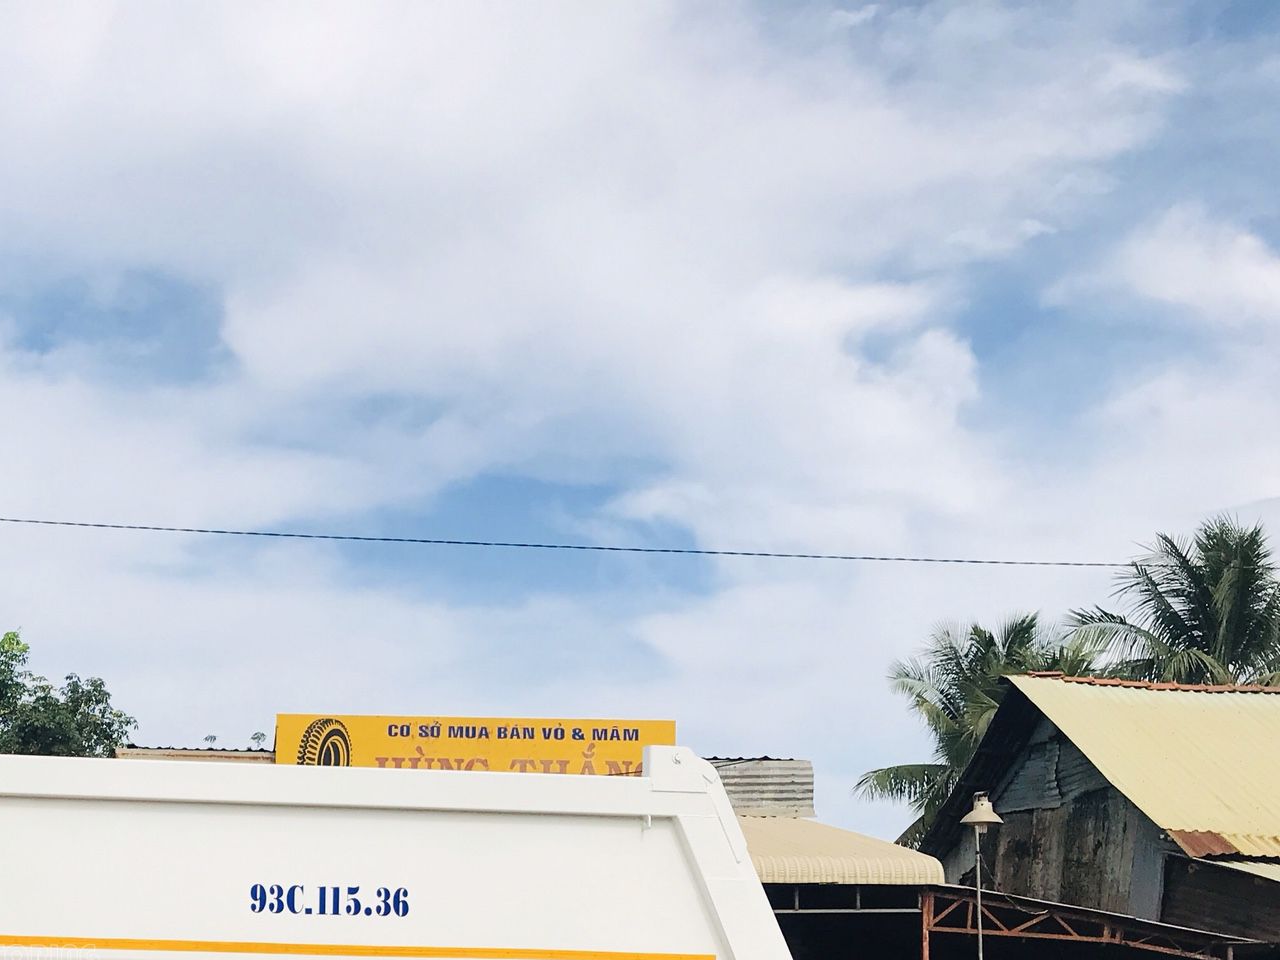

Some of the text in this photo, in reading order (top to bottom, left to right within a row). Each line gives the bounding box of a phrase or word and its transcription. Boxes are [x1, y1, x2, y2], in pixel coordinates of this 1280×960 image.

[448, 725, 490, 739] MUA
[542, 722, 565, 740] VỎ
[572, 728, 585, 741] &
[250, 883, 409, 917] 93C.115.36
